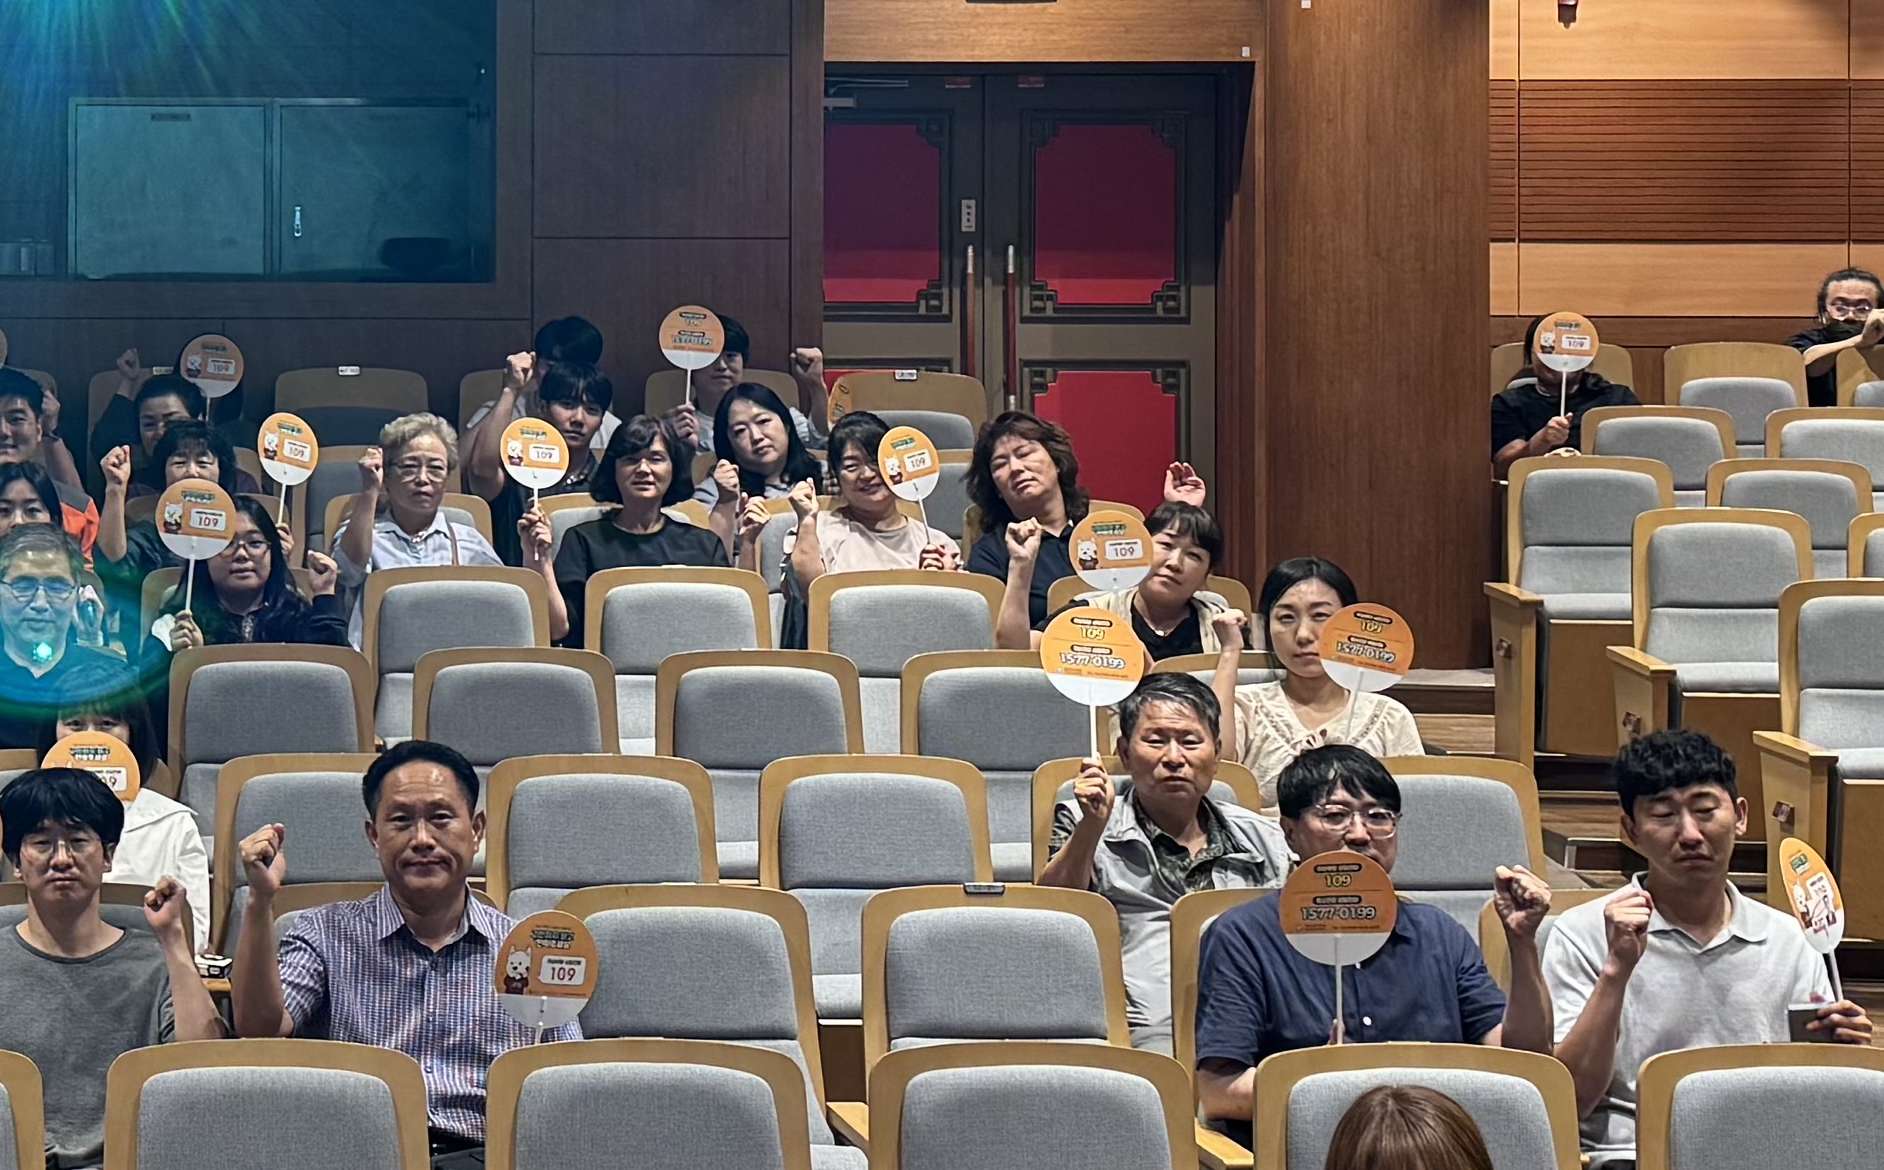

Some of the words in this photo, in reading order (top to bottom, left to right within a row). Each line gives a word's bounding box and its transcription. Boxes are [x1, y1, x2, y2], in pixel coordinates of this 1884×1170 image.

[289, 449, 304, 457] 109
[536, 450, 552, 459] 109
[198, 517, 218, 527] 109
[1114, 547, 1135, 557] 109
[1080, 626, 1105, 640] 109
[1361, 620, 1384, 634] 109
[1325, 874, 1351, 887] 109
[1300, 906, 1376, 920] 1577-0199
[551, 967, 576, 981] 109
